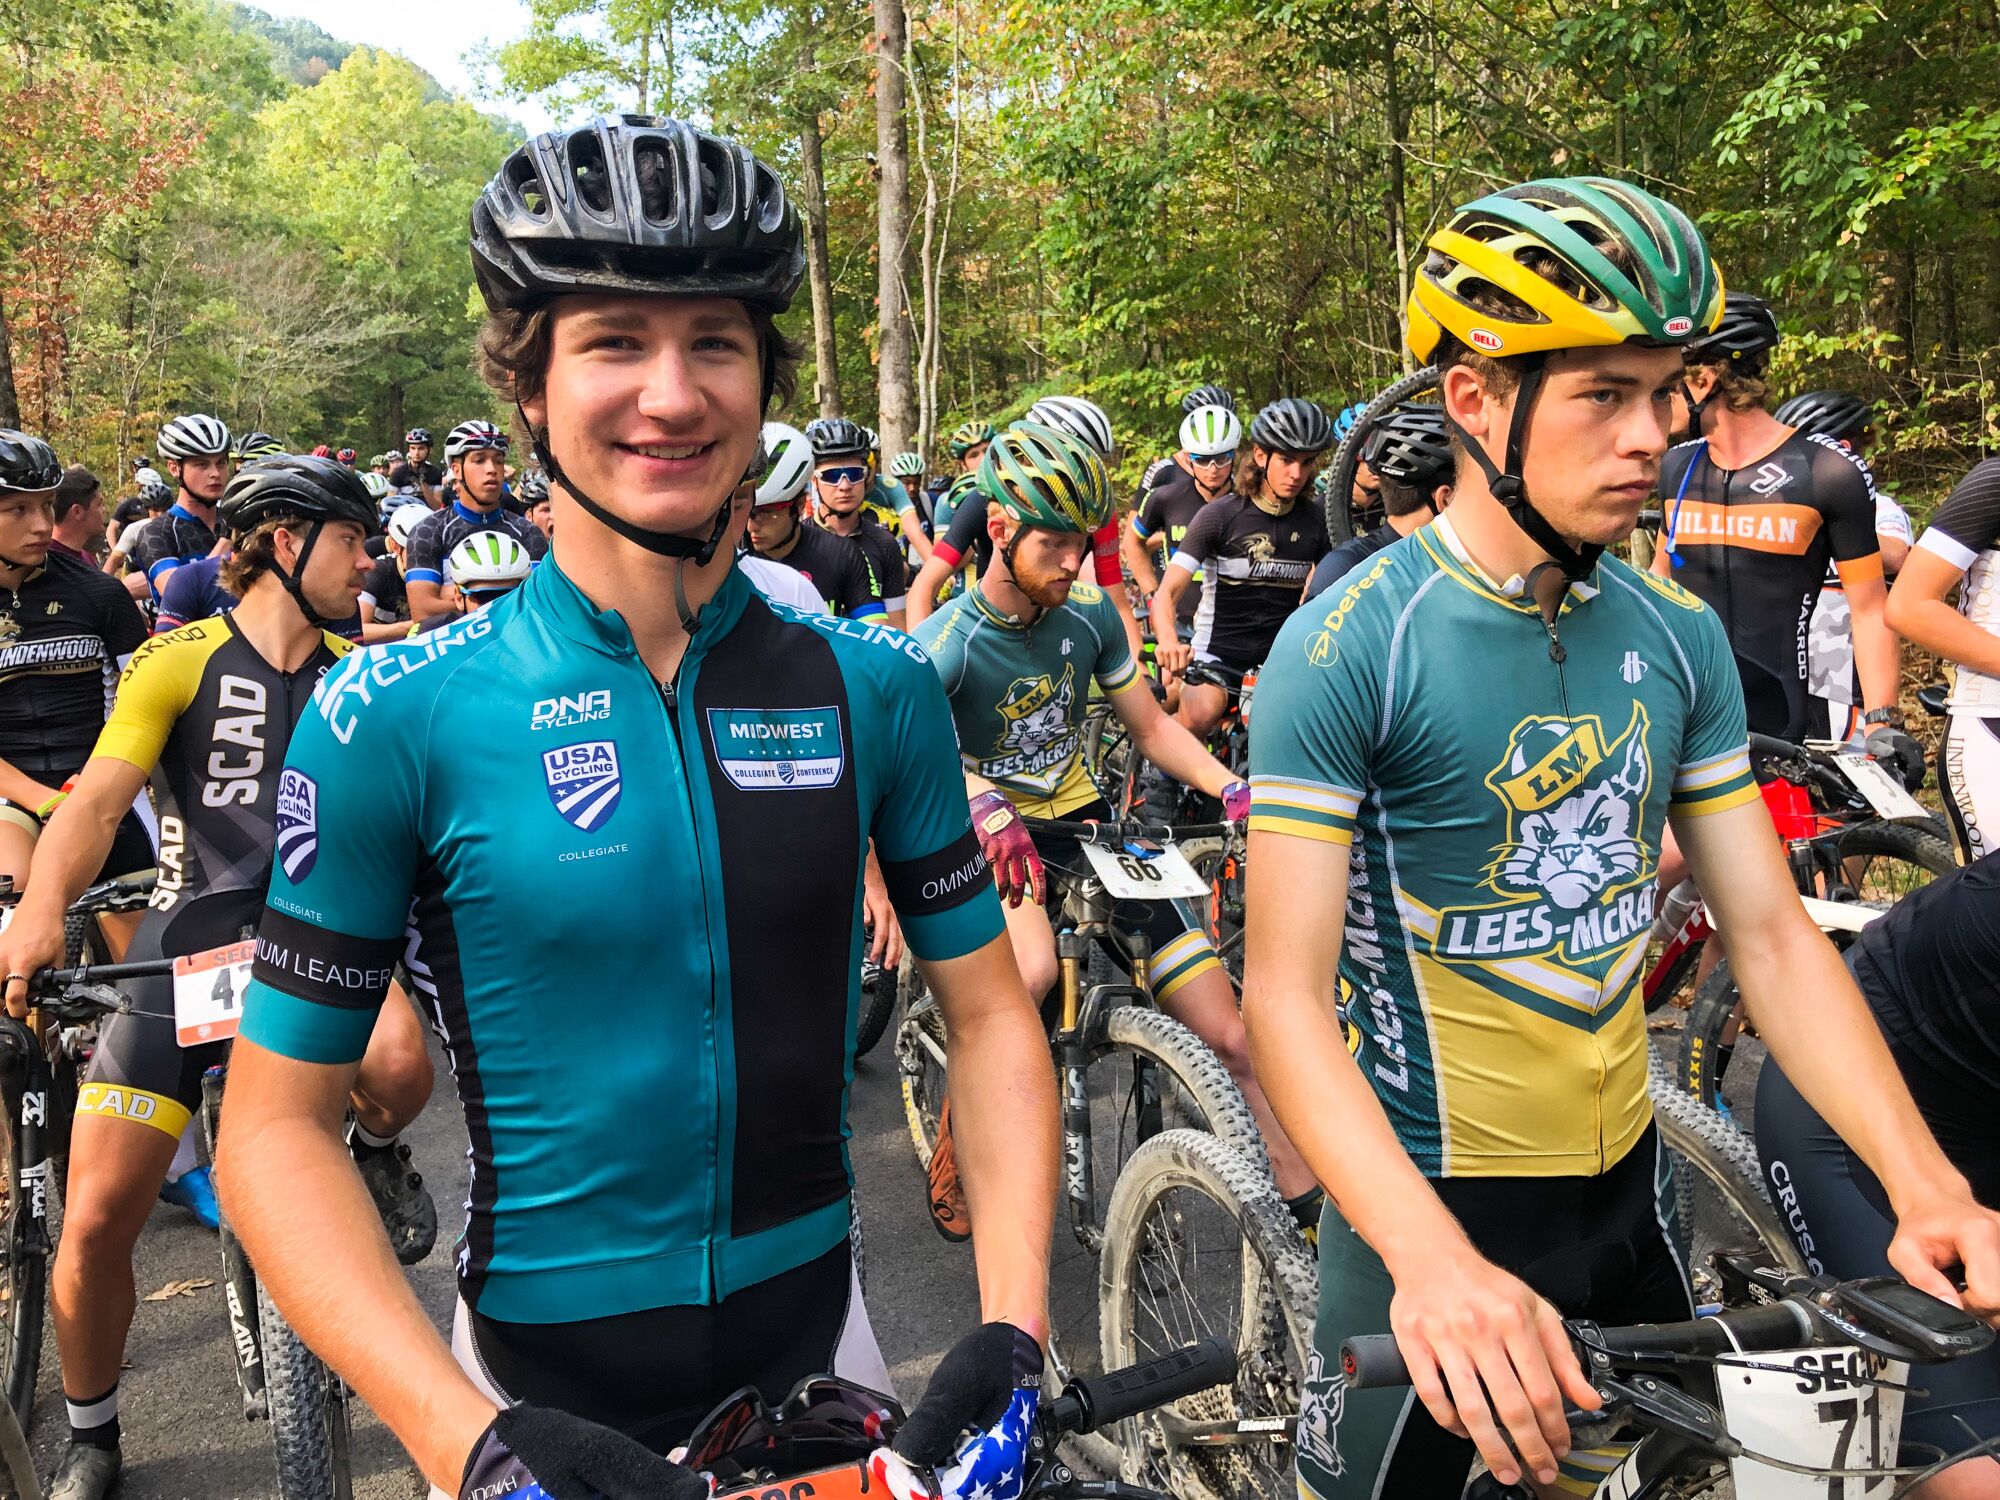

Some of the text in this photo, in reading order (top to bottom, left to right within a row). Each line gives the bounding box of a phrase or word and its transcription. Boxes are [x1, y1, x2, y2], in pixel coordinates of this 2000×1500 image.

[1473, 332, 1499, 349] BELL
[1669, 321, 1691, 332] BELL
[1070, 585, 1097, 599] ELL
[1323, 556, 1394, 632] DeFeet
[766, 596, 929, 664] CYCLING
[123, 626, 208, 683] JAKROO
[329, 613, 493, 744] CYCLING
[532, 689, 612, 719] DNA
[1015, 685, 1045, 714] LM
[530, 709, 612, 731] CYCLING
[729, 722, 824, 740] MIDWEST
[202, 674, 267, 807] SCAD
[550, 745, 612, 770] USA
[552, 762, 614, 782] CYCLING
[796, 766, 834, 777] CONFERENCE
[1527, 741, 1590, 802] LM
[734, 769, 776, 778] COLLEGIATE
[1948, 737, 1986, 861] LINDENWOOD
[149, 816, 184, 913] SCAD
[558, 843, 629, 863] COLLEGIATE
[921, 851, 986, 899] OMNIUM
[1116, 856, 1163, 882] 66
[273, 896, 323, 923] COLLEGIATE
[294, 953, 391, 989] LEADER
[1065, 1130, 1085, 1194] FOX
[32, 1179, 46, 1219] FOX
[225, 1281, 260, 1368] BRAIN
[1237, 1417, 1286, 1432] Bianchi
[1817, 1388, 1887, 1500] 71
